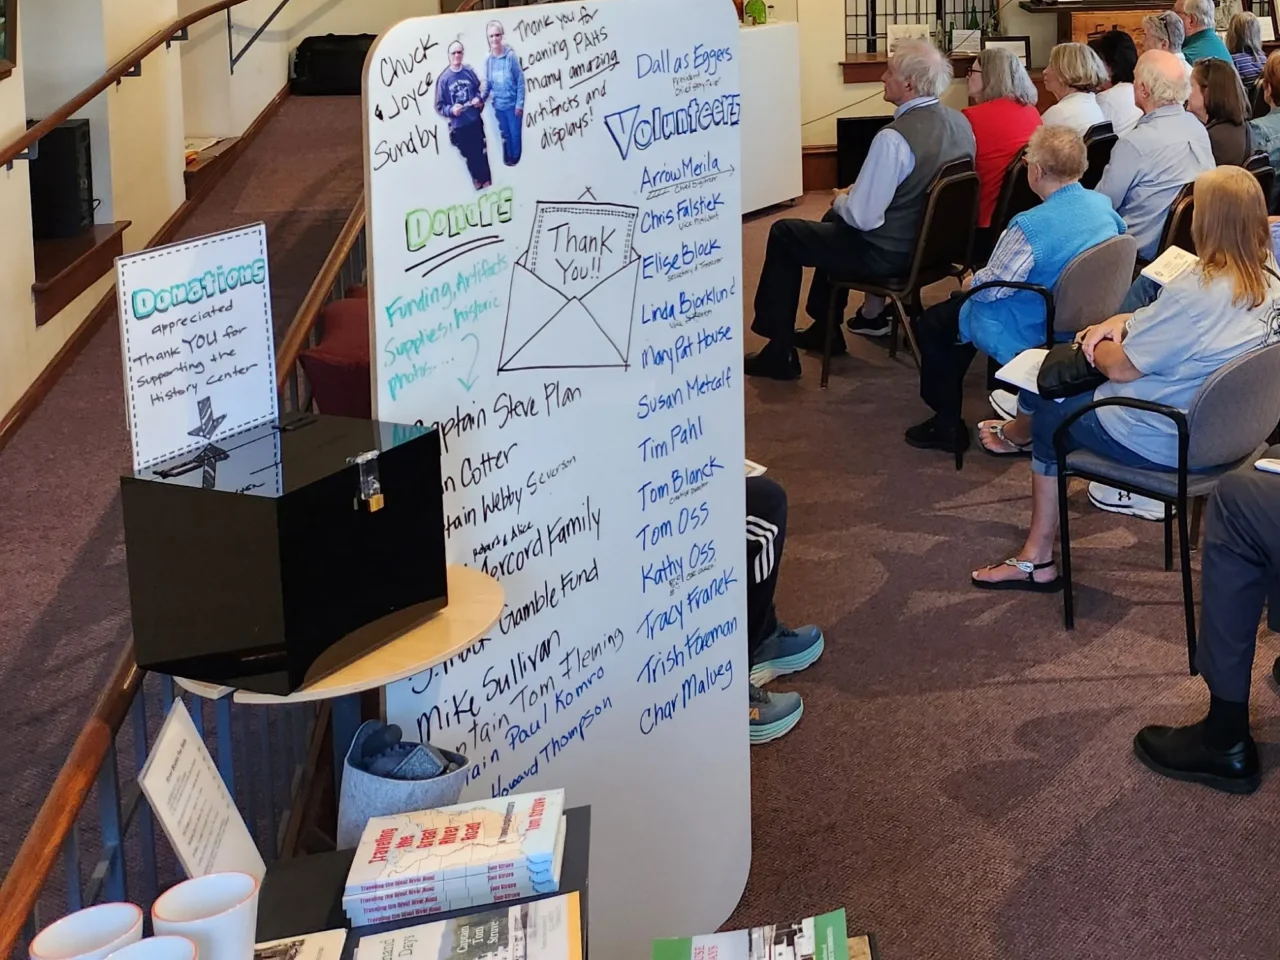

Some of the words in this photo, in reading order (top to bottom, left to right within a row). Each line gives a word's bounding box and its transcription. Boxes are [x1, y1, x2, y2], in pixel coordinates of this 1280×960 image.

[513, 7, 553, 41] Thank
[558, 10, 576, 30] you
[578, 6, 598, 28] for
[380, 34, 439, 87] Chuck
[519, 39, 568, 72] Loaning
[574, 26, 608, 53] PAHS
[527, 69, 562, 92] many
[569, 48, 620, 80] amazing
[636, 48, 689, 79] Dallas
[693, 44, 733, 75] Eggers
[389, 72, 433, 119] Joyce
[526, 96, 580, 127] artifacts
[585, 80, 607, 105] and
[374, 124, 439, 171] Sundby
[540, 109, 594, 150] displays!
[604, 94, 740, 160] Volunteers
[640, 166, 681, 193] Arrow
[548, 222, 616, 256] Thank
[641, 209, 674, 233] Chris
[555, 257, 600, 285] You!!
[643, 252, 681, 280] Elise
[682, 239, 721, 265] Block
[131, 258, 266, 320] Donations
[385, 282, 456, 327] Funding,
[151, 299, 234, 335] appreciated
[642, 300, 676, 324] Linda
[133, 344, 181, 369] Thank
[181, 329, 218, 354] YOU
[222, 325, 248, 339] for
[136, 358, 206, 388] Supporting
[210, 347, 237, 364] the
[642, 345, 674, 375] Mary
[675, 335, 693, 363] Pat
[697, 326, 733, 354] House
[150, 382, 198, 407] History
[206, 363, 259, 386] Center
[637, 388, 683, 419] Susan
[686, 366, 731, 400] Metcalf
[414, 401, 487, 453] ptain
[493, 393, 539, 428] Steve
[543, 380, 582, 416] Plan
[638, 437, 668, 462] Tim
[671, 415, 703, 451] Pahl
[460, 443, 518, 487] Cotter
[638, 481, 669, 511] Tom
[671, 455, 724, 493] Blanck
[443, 506, 477, 539] tain
[482, 485, 522, 522] Webby
[526, 455, 576, 495] Severson
[547, 495, 601, 556] Family
[636, 524, 673, 551] Tom
[641, 554, 684, 593] Kathy
[499, 580, 560, 635] Gamble
[560, 558, 599, 598] Fund
[636, 600, 683, 640] Tracy
[687, 567, 737, 613] Franek
[417, 689, 481, 743] Mike
[482, 629, 561, 701] Sullivan
[509, 676, 555, 713] Tom
[559, 627, 624, 679] Fleming
[636, 645, 684, 684] Trish
[505, 702, 548, 751] Paul
[555, 666, 605, 713] Komro
[539, 695, 613, 764] Thompson
[640, 693, 678, 735] Char
[525, 817, 543, 835] Tom
[529, 797, 547, 818] Struve
[416, 827, 438, 849] Great
[438, 825, 460, 845] River
[461, 822, 482, 841] Road
[398, 934, 417, 957] Days
[457, 925, 469, 952] Captain
[471, 925, 484, 945] Tom
[487, 920, 499, 944] Struve
